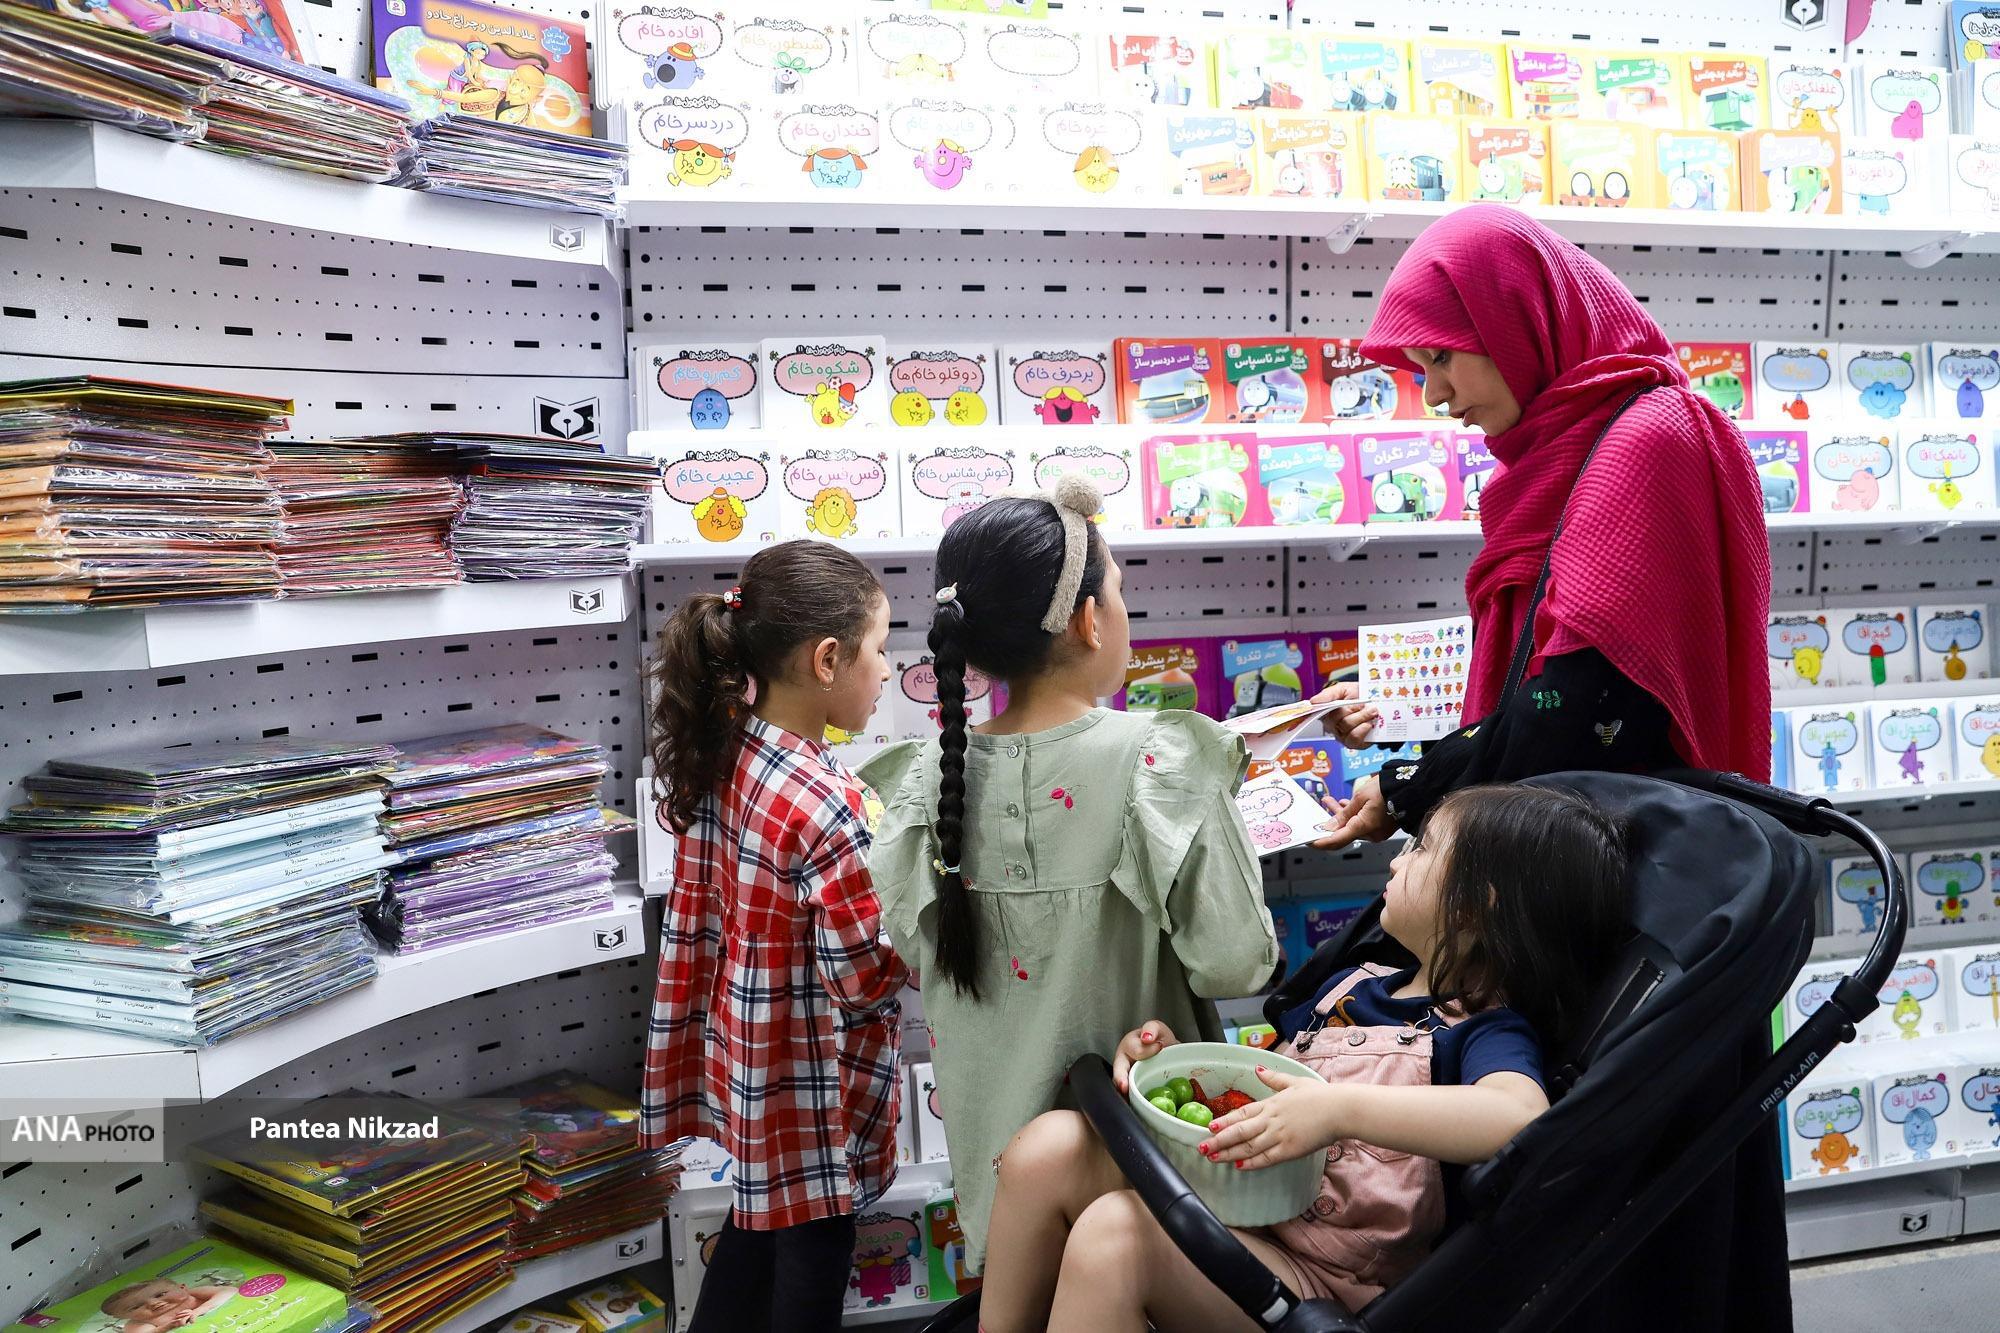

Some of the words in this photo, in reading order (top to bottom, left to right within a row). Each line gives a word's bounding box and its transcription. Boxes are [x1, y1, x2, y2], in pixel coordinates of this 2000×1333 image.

[426, 9, 452, 24] جادو
[453, 15, 479, 31] چراغ
[637, 22, 666, 40] خانم
[653, 112, 682, 133] خانم
[791, 120, 820, 141] خانم
[673, 364, 699, 384] خانم
[787, 361, 814, 380] خانم
[816, 360, 860, 380] شکوه
[911, 366, 936, 384] خانم
[1025, 365, 1050, 383] خانم
[676, 467, 704, 488] خانم
[706, 470, 755, 487] عجیب
[789, 465, 816, 486] خانم
[916, 466, 937, 482] خانم
[1040, 463, 1063, 481] خانم
[1126, 654, 1166, 669] پیشرفت
[913, 670, 938, 689] خانم
[1760, 1087, 1784, 1112] IRIS
[1784, 1052, 1820, 1089] M-AIR
